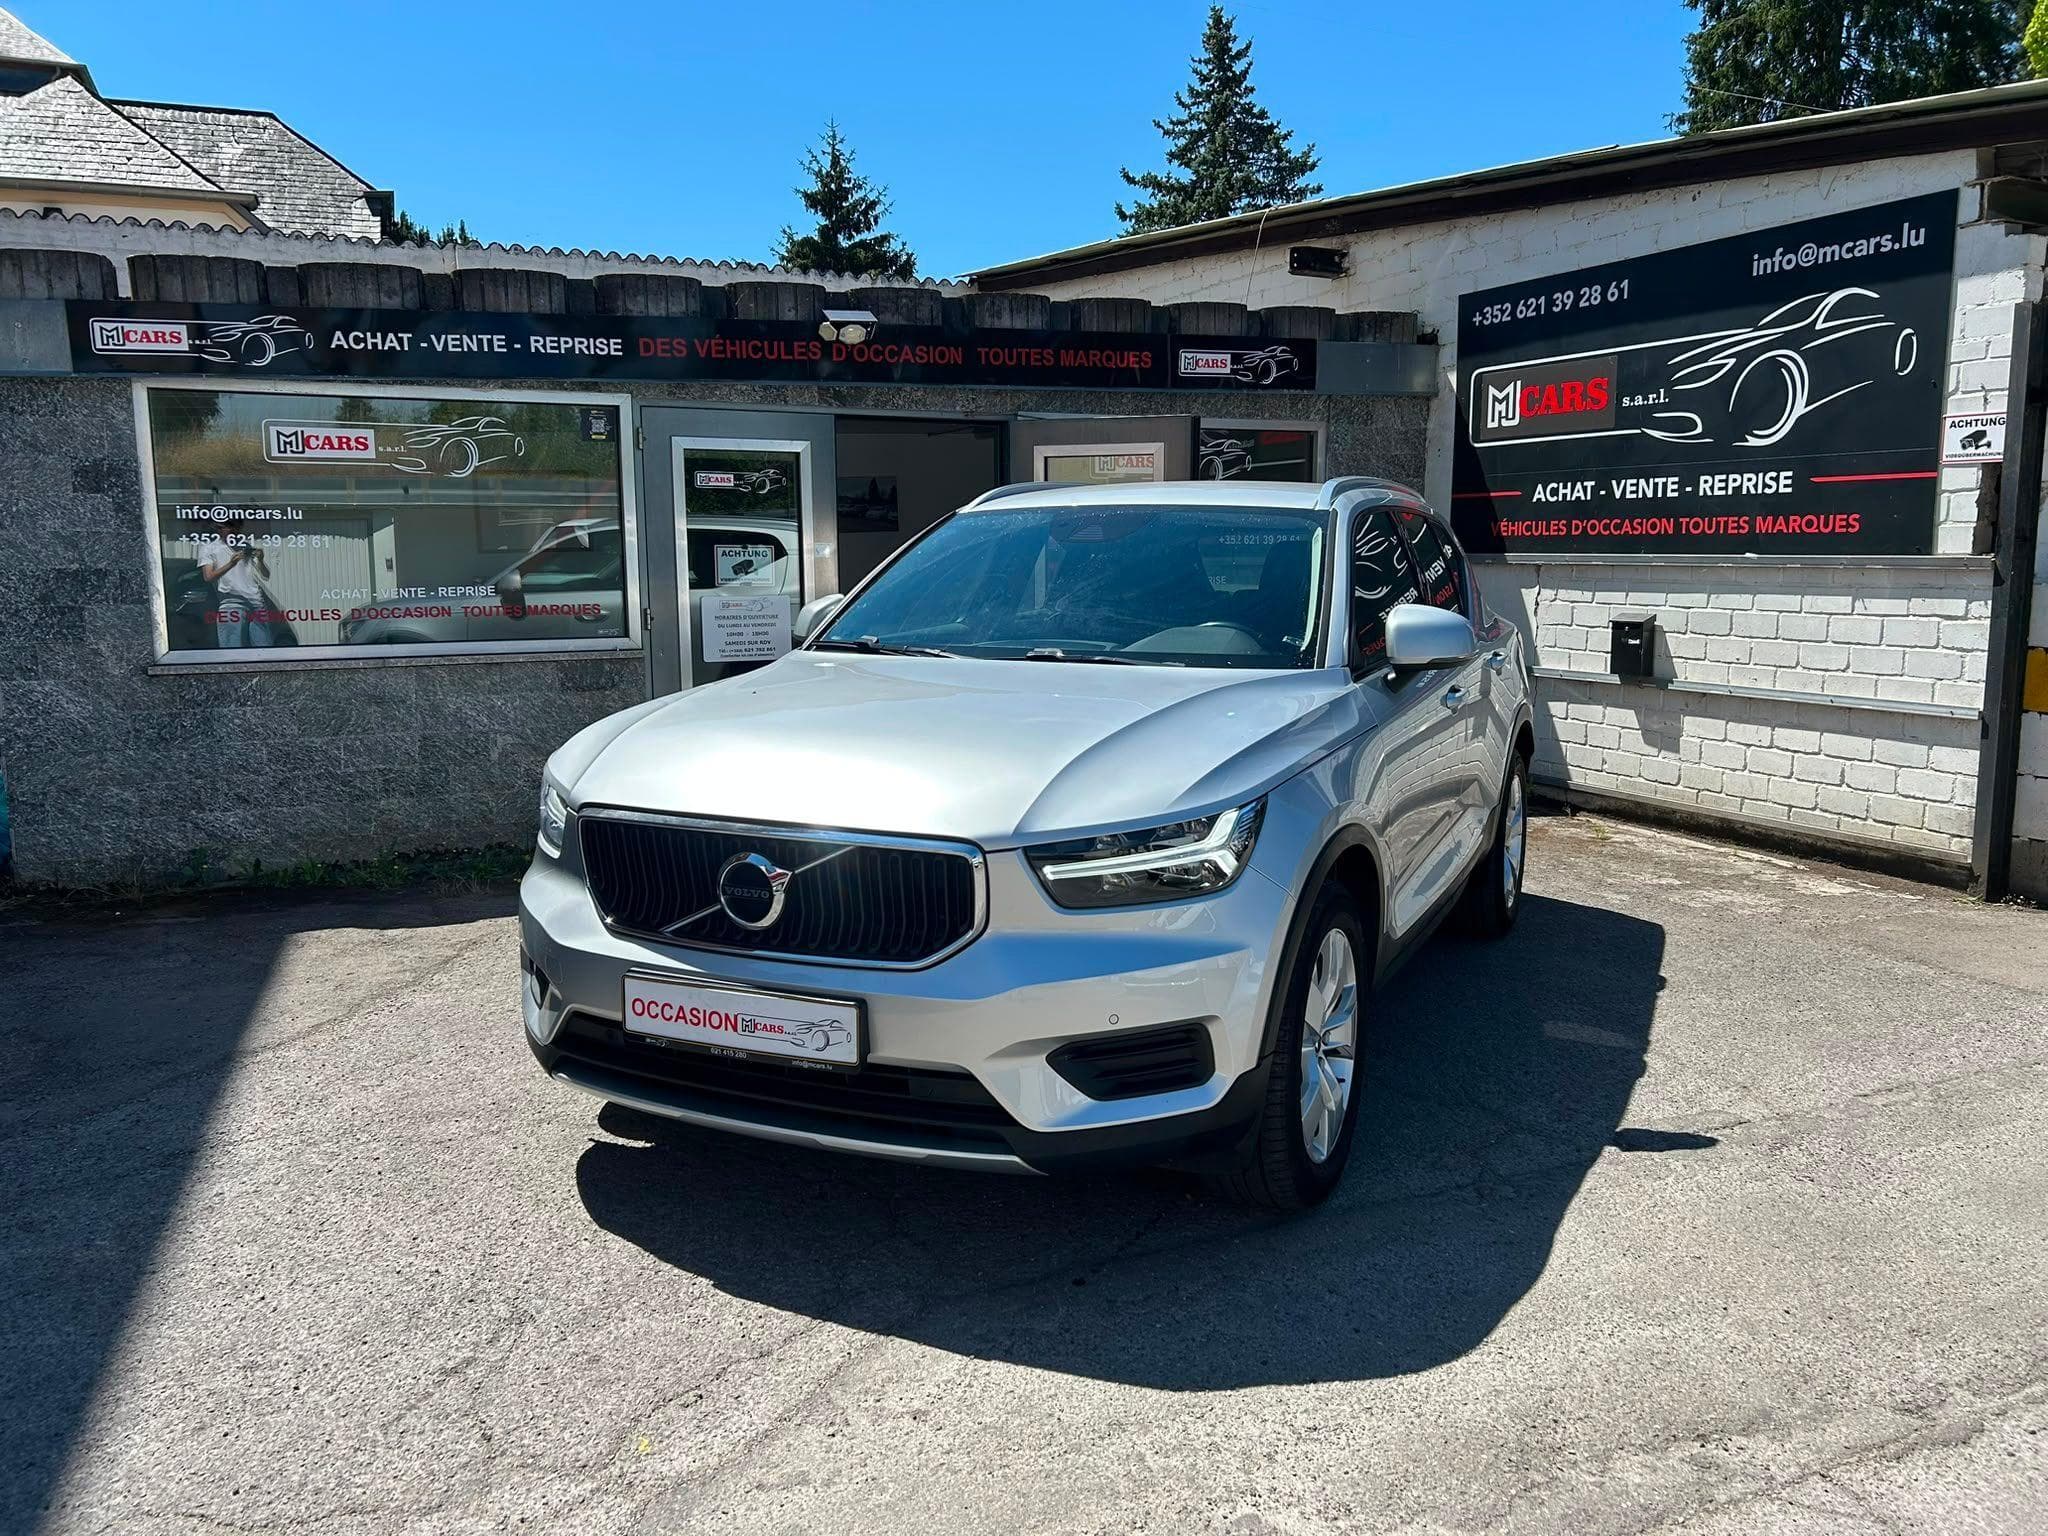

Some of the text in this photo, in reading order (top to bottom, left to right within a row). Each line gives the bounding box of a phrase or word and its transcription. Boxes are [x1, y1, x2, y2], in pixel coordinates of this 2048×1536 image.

[1752, 222, 1926, 277] info@mcars.lu
[1472, 278, 1629, 327] +352 621 39 28 61
[330, 330, 413, 351] ACHAT
[529, 335, 624, 356] REPRISE
[638, 336, 688, 358] DES
[693, 334, 823, 360] VÉHICULES
[832, 343, 963, 365] D'OCCASION
[976, 347, 1055, 367] TOUTES
[1060, 349, 1153, 369] MARQUES
[1621, 388, 1670, 407] s.a.r.l.
[1949, 416, 2006, 429] ACHTUNG
[1532, 481, 1596, 502] ACHAT
[1610, 477, 1680, 499] VENTE
[1698, 471, 1794, 496] REPRISE
[175, 505, 303, 523] info@mcars.lu
[1490, 513, 1861, 537] VÉHICULES D'OCCASION TOUTES MARQUES
[178, 532, 329, 549] +352 621 39 28 61
[1244, 535, 1260, 545] 621
[1262, 535, 1274, 545] 39
[721, 549, 769, 558] ACHTUNG
[321, 587, 368, 600] ACHAT
[381, 586, 426, 599] VENTE
[438, 585, 496, 598] REPRISE
[205, 610, 241, 624] DES
[351, 605, 452, 620] D'OCCASION
[461, 604, 526, 618] TOUTES
[526, 603, 601, 617] MARQUES
[724, 886, 770, 899] VOLVO
[631, 997, 738, 1033] OCCASION
